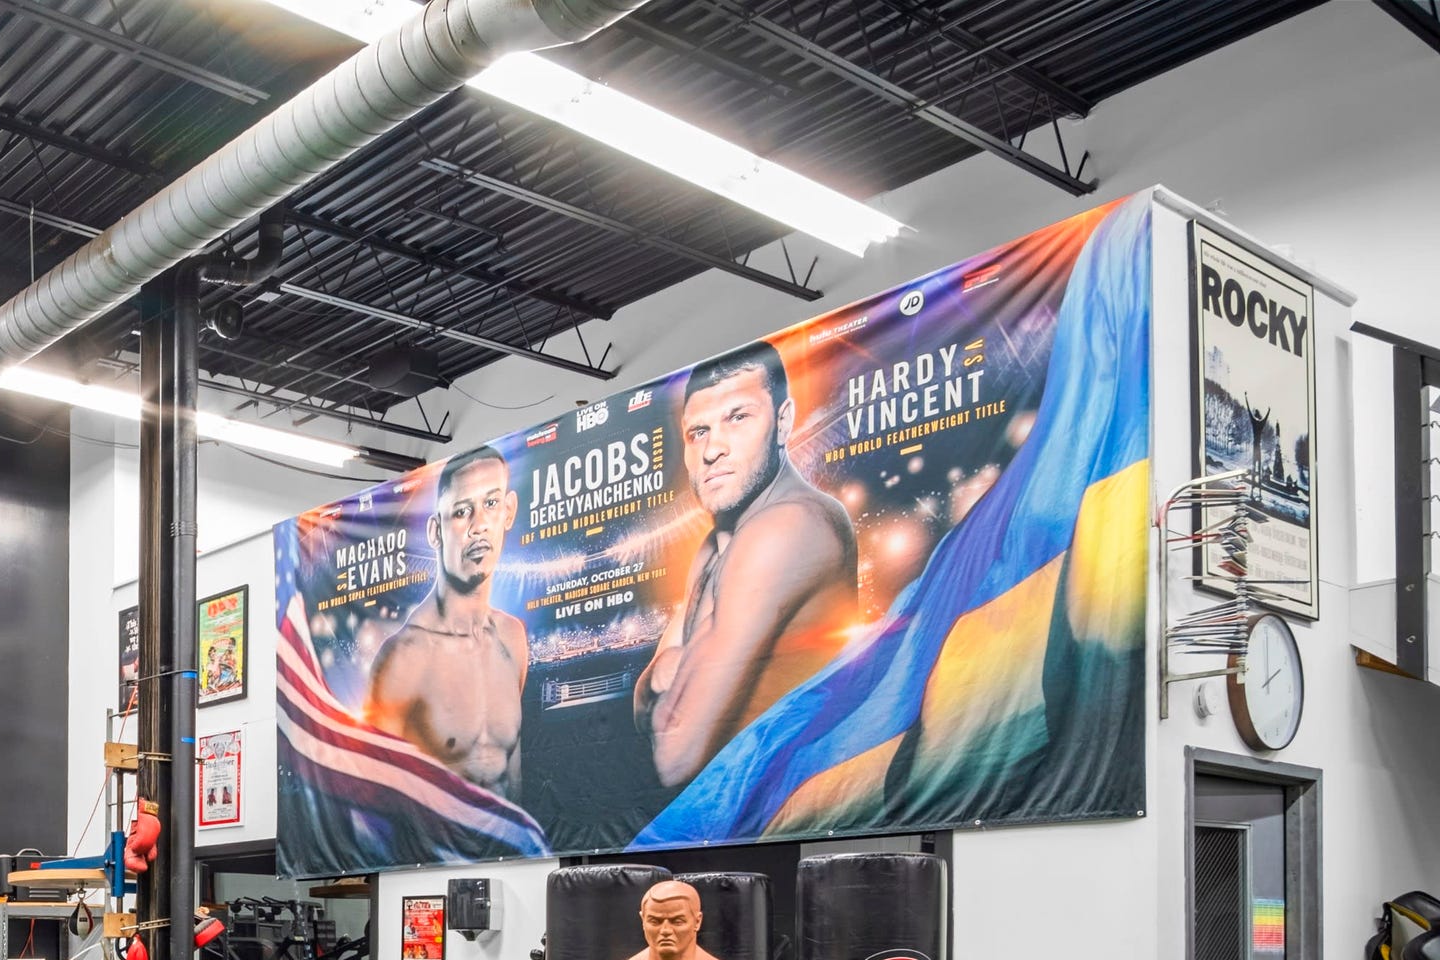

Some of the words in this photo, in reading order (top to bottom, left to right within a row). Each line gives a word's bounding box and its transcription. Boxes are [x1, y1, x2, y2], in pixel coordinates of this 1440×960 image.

[1201, 263, 1307, 358] ROCKY
[963, 337, 984, 367] VS
[848, 343, 957, 407] HARDY
[576, 405, 594, 417] LIVE
[576, 408, 609, 433] HBO
[847, 370, 984, 439] VINCENT
[652, 427, 663, 471] VERSUS
[824, 448, 845, 464] WBO
[849, 437, 882, 457] WORLD
[886, 411, 970, 446] FEATHERWEIGHT
[975, 400, 1006, 420] TITLE
[529, 432, 650, 510] JACOBS
[530, 470, 664, 528] DEREVYANCHENKO
[539, 522, 569, 539] WORLD
[572, 500, 642, 530] MIDDLEWEIGHT
[647, 490, 675, 509] TITLE
[336, 529, 407, 569] MACHADO
[337, 572, 347, 591] VS
[347, 551, 407, 591] EVANS
[546, 576, 589, 595] SATURDAY,
[591, 565, 631, 583] OCTOBER
[633, 562, 644, 572] 27
[637, 573, 650, 583] NEW
[348, 590, 365, 602] SUPER
[555, 603, 581, 619] LIVE
[584, 598, 603, 611] ON
[607, 591, 634, 608] HBO
